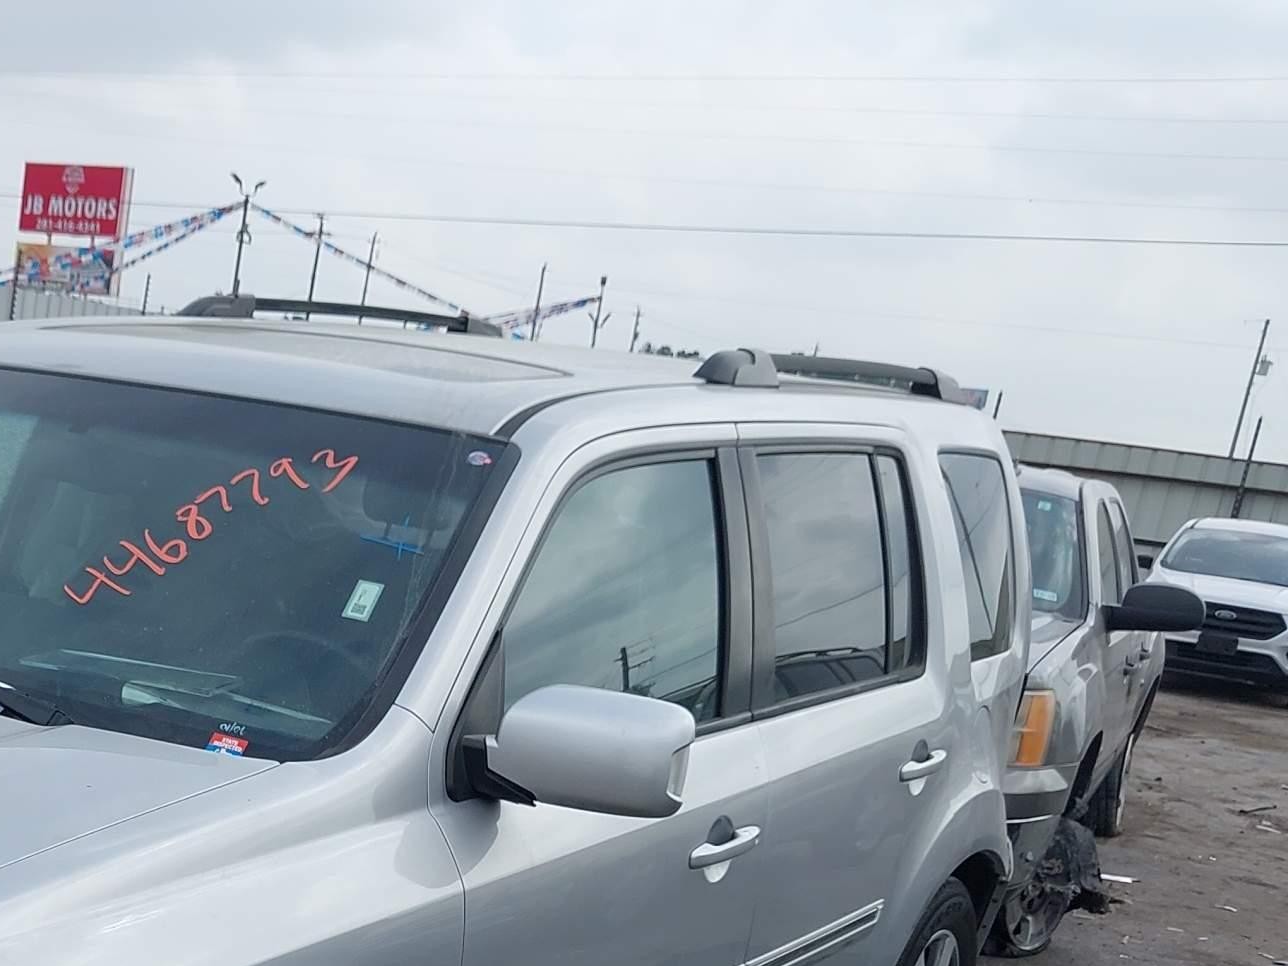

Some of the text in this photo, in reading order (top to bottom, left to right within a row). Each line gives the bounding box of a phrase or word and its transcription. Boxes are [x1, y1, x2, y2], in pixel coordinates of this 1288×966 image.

[24, 194, 117, 220] JB MOTORS
[64, 449, 359, 604] 44687793
